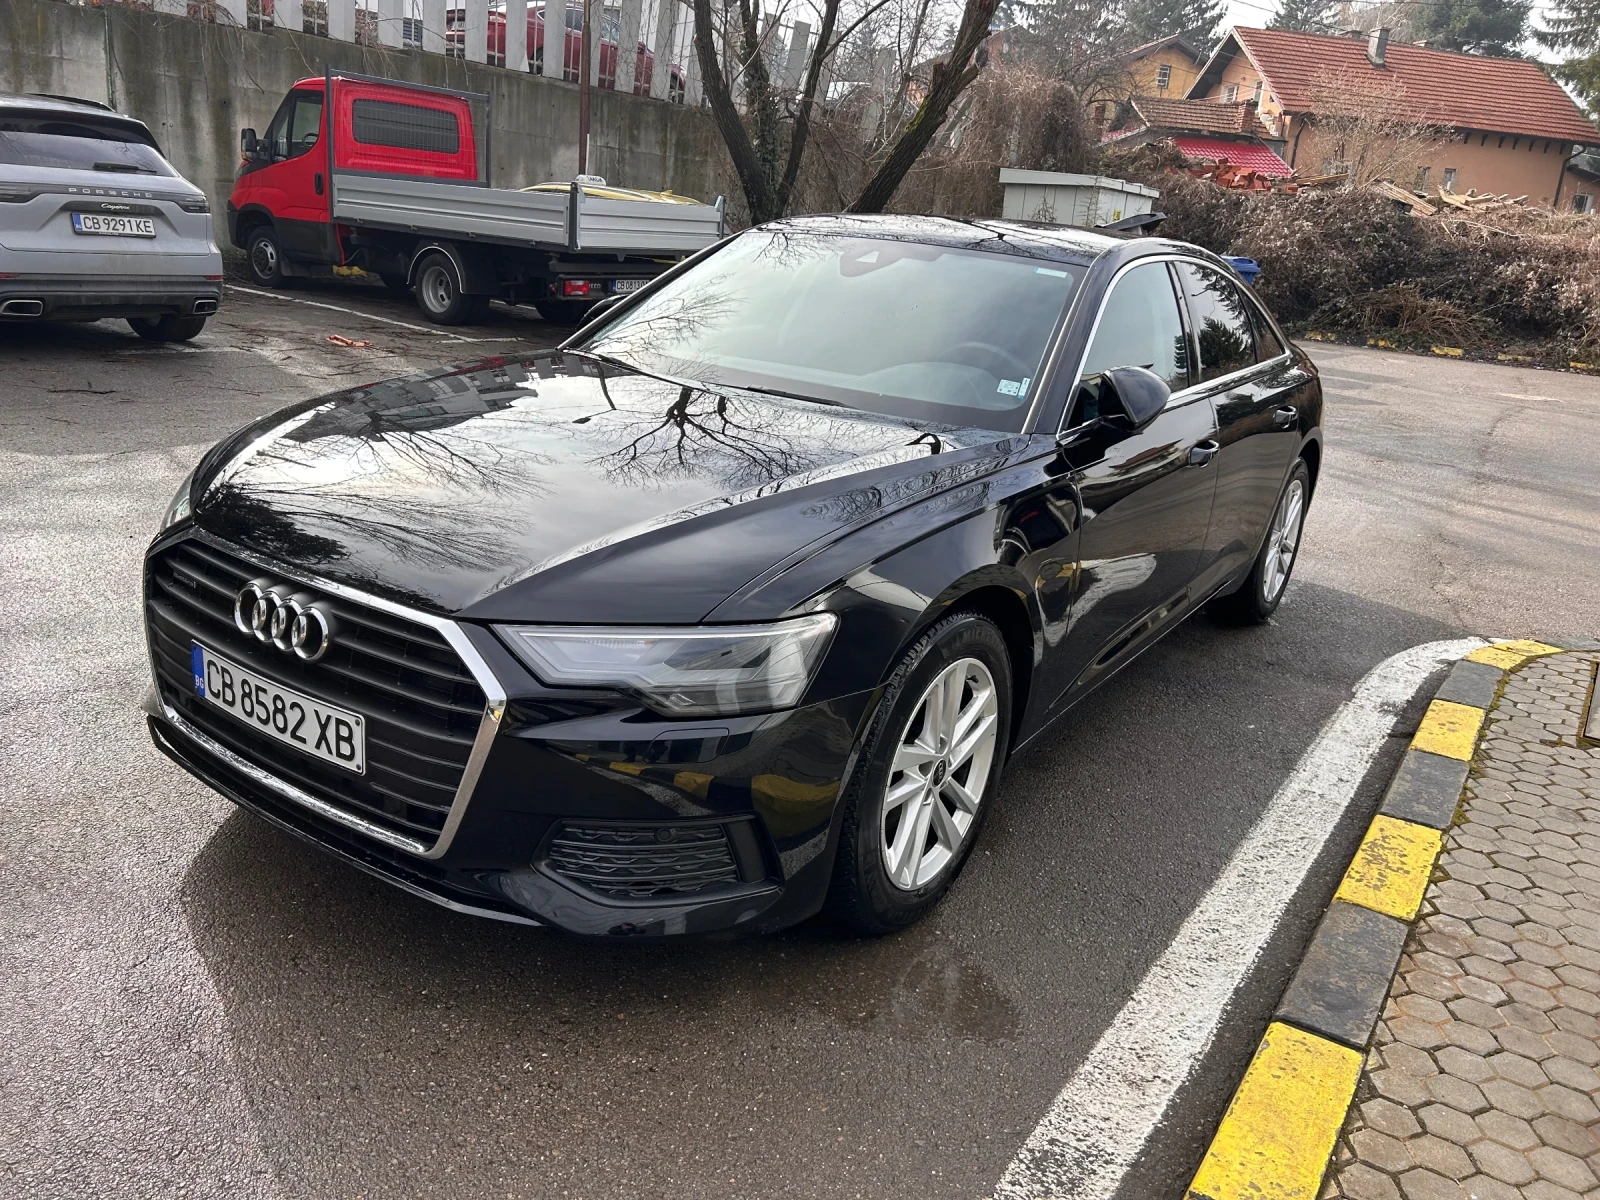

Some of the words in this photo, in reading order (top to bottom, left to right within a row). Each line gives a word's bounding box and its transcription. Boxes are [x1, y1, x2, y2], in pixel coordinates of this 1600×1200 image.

[68, 187, 152, 198] PORSCHE
[83, 216, 101, 230] CB
[102, 217, 133, 232] 9291
[134, 219, 153, 233] KE
[616, 280, 625, 290] CB
[194, 674, 205, 689] BG
[206, 659, 236, 708] CB
[240, 679, 307, 745] 8582
[313, 708, 356, 763] XB
